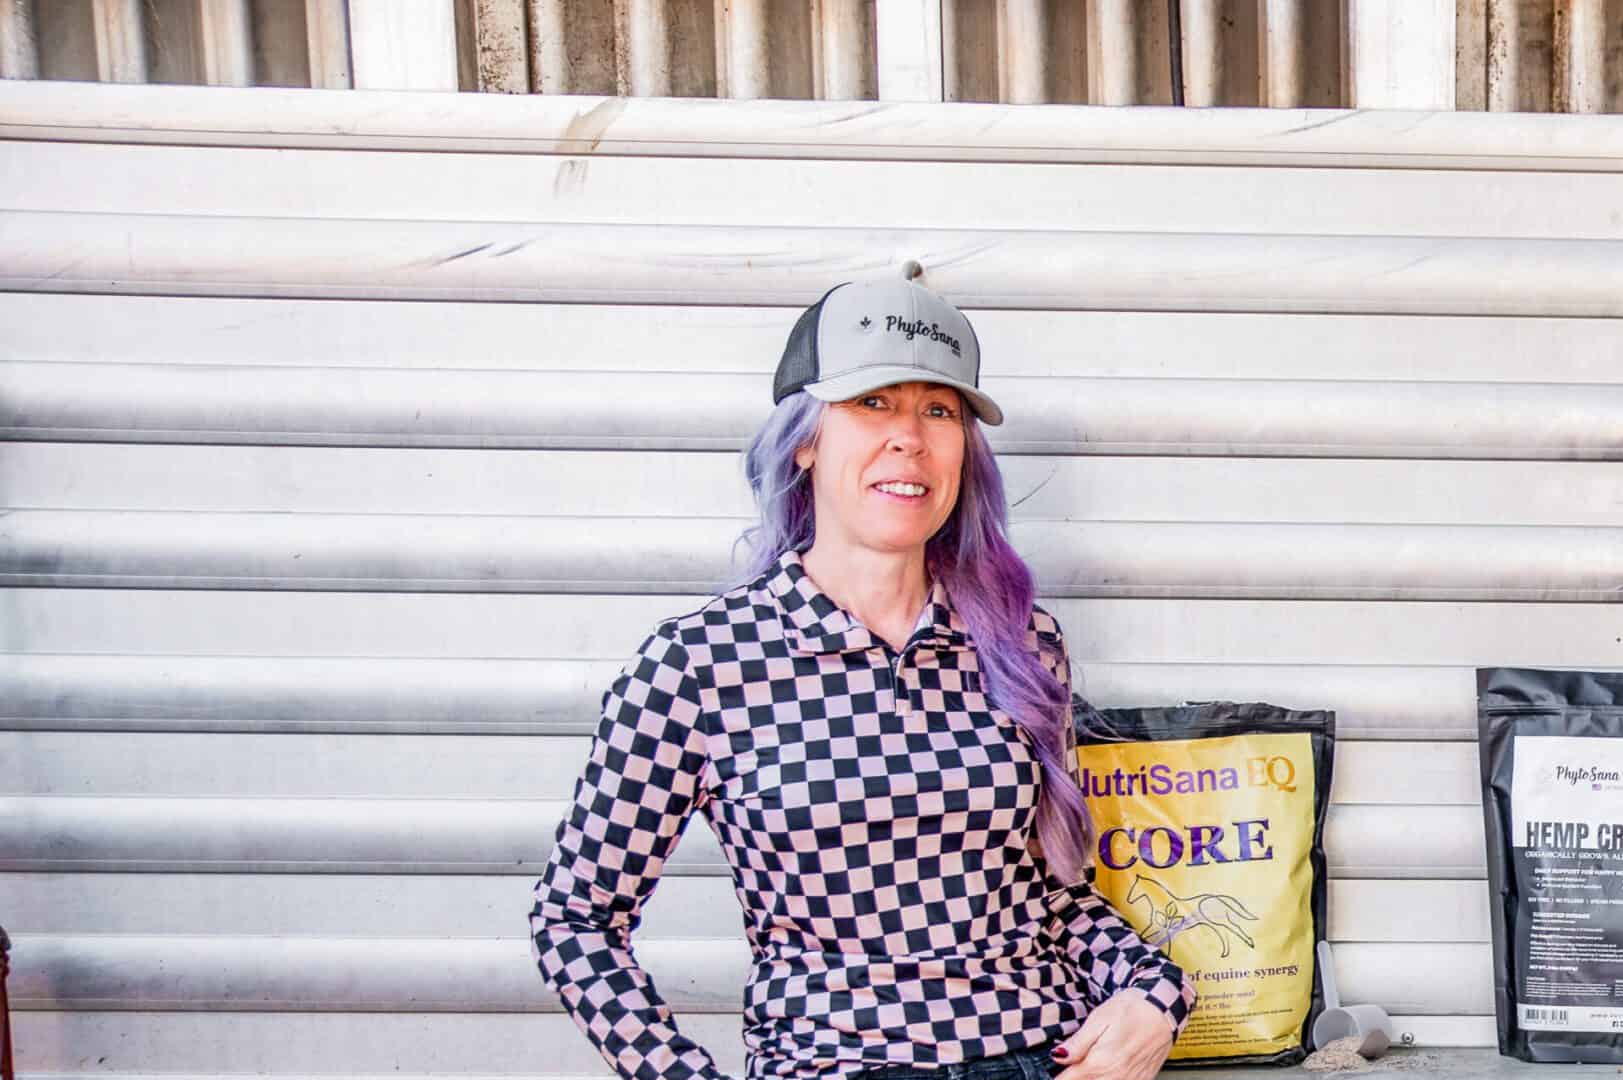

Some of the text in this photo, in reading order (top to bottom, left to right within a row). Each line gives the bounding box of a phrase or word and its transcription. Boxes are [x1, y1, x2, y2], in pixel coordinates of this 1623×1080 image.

[886, 315, 961, 351] PhytoSana
[1247, 755, 1297, 792] EQ
[1098, 818, 1274, 871] CORE
[1526, 821, 1589, 850] HEMP
[1203, 967, 1249, 983] equine
[1254, 964, 1299, 980] synergy
